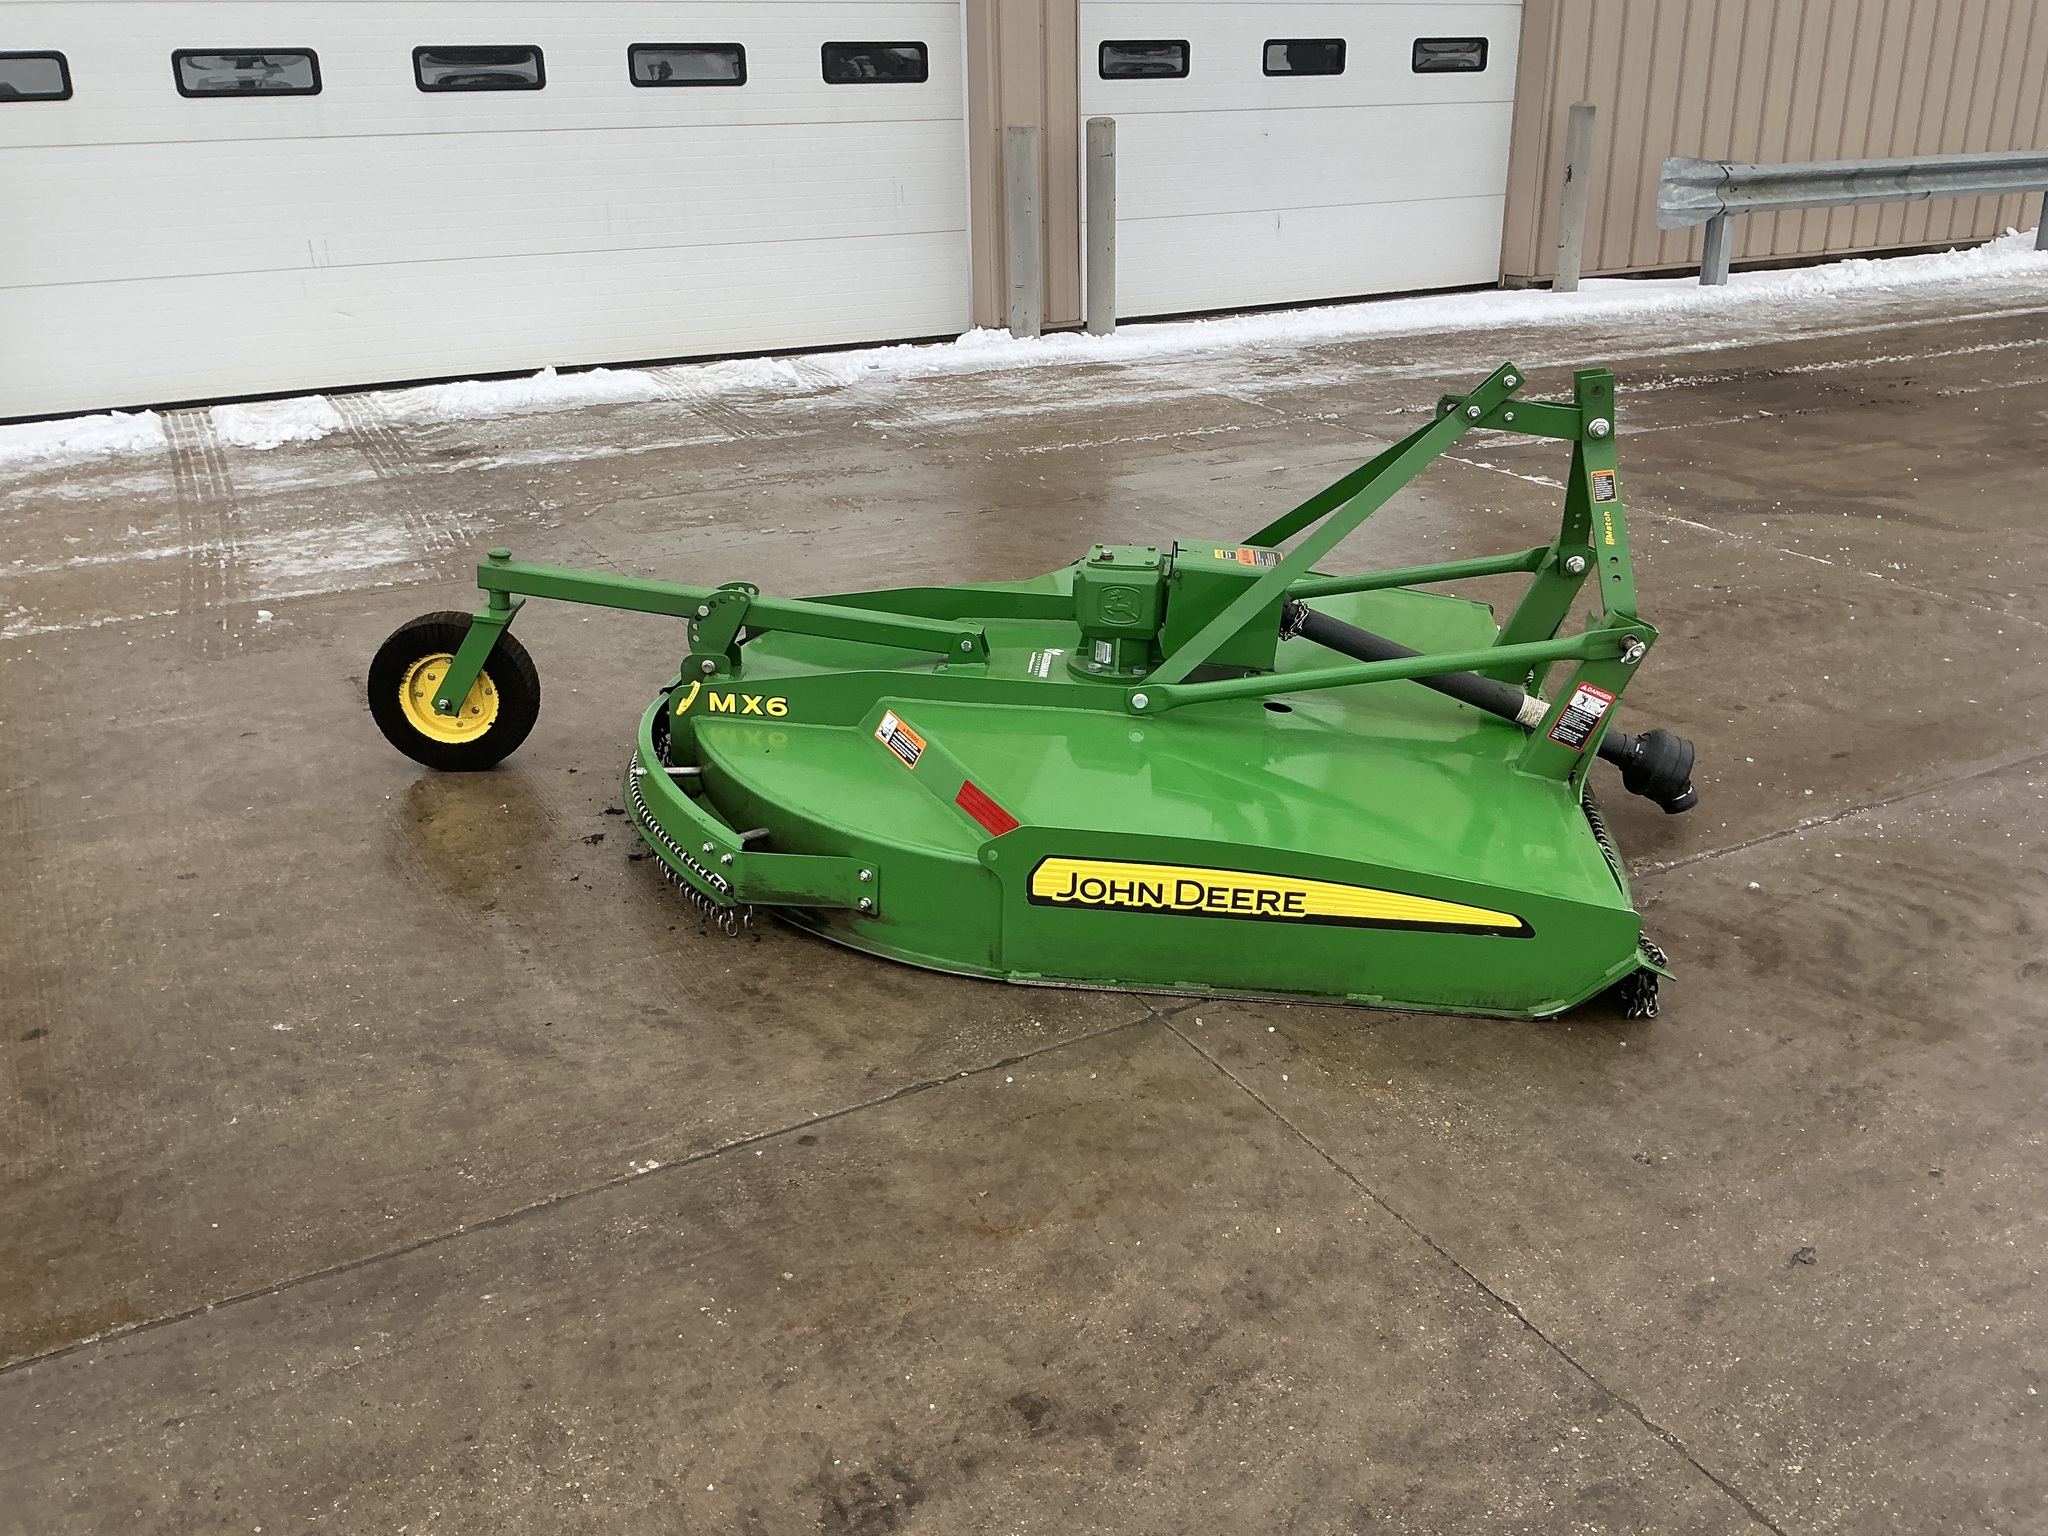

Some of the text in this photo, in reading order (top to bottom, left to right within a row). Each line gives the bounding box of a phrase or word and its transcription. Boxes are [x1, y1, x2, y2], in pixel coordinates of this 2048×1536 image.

[709, 691, 789, 718] MX6
[1586, 687, 1613, 702] DANGER
[1056, 872, 1307, 914] JOHN DEERE
